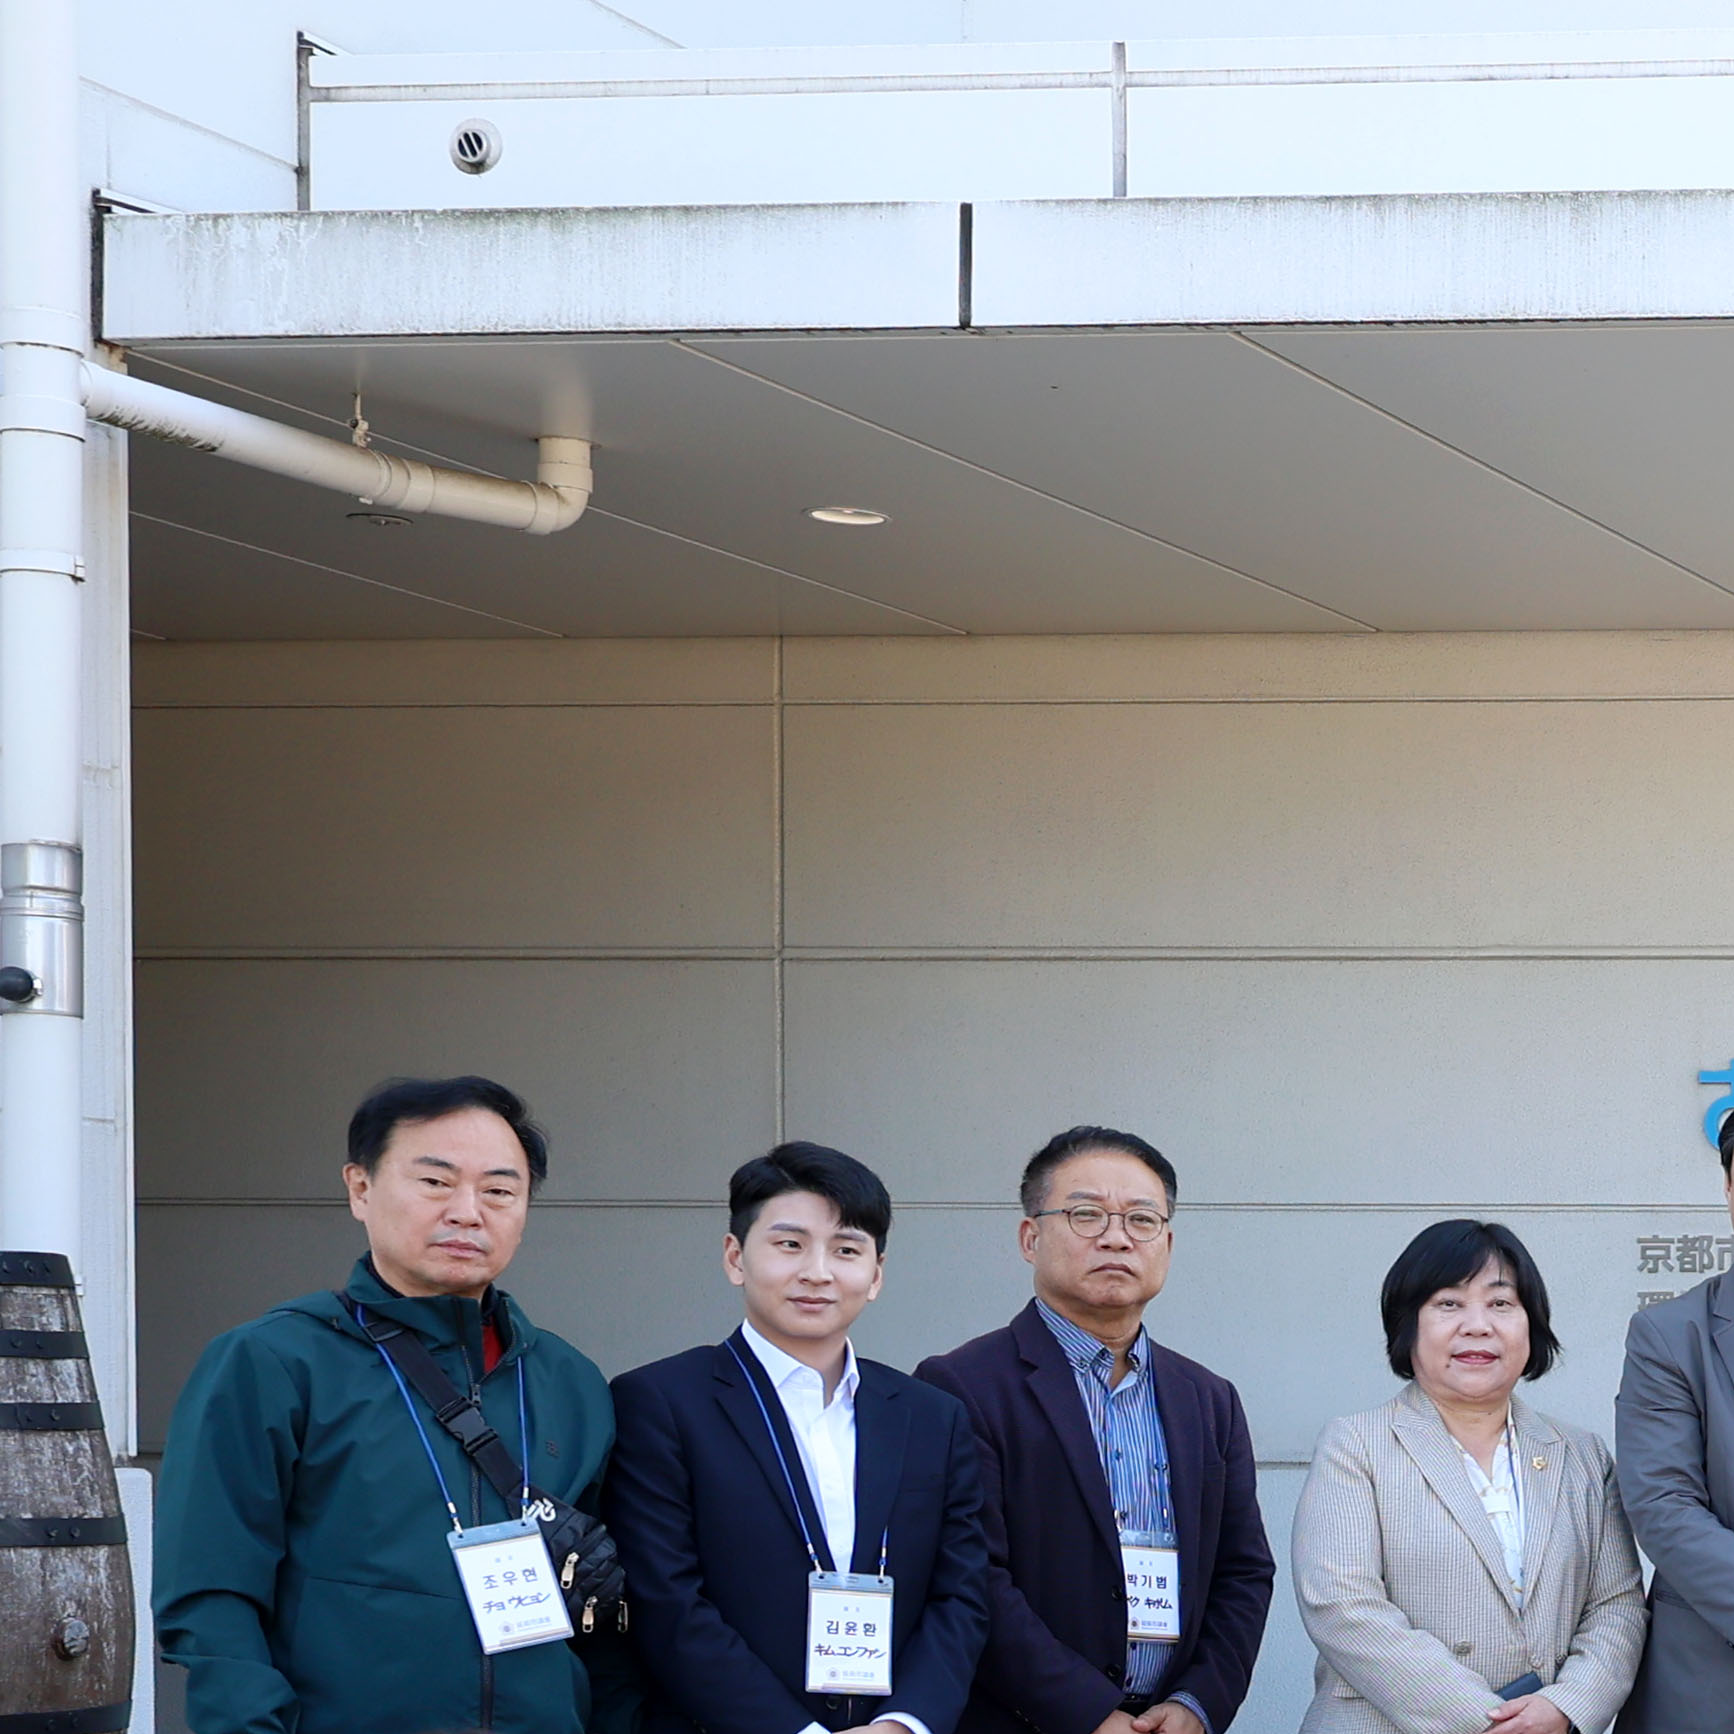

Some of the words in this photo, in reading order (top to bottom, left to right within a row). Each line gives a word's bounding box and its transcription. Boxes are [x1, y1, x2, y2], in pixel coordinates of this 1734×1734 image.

[482, 1567, 538, 1590] 조우현
[1127, 1574, 1167, 1589] 박기범
[826, 1620, 877, 1637] 김윤환
